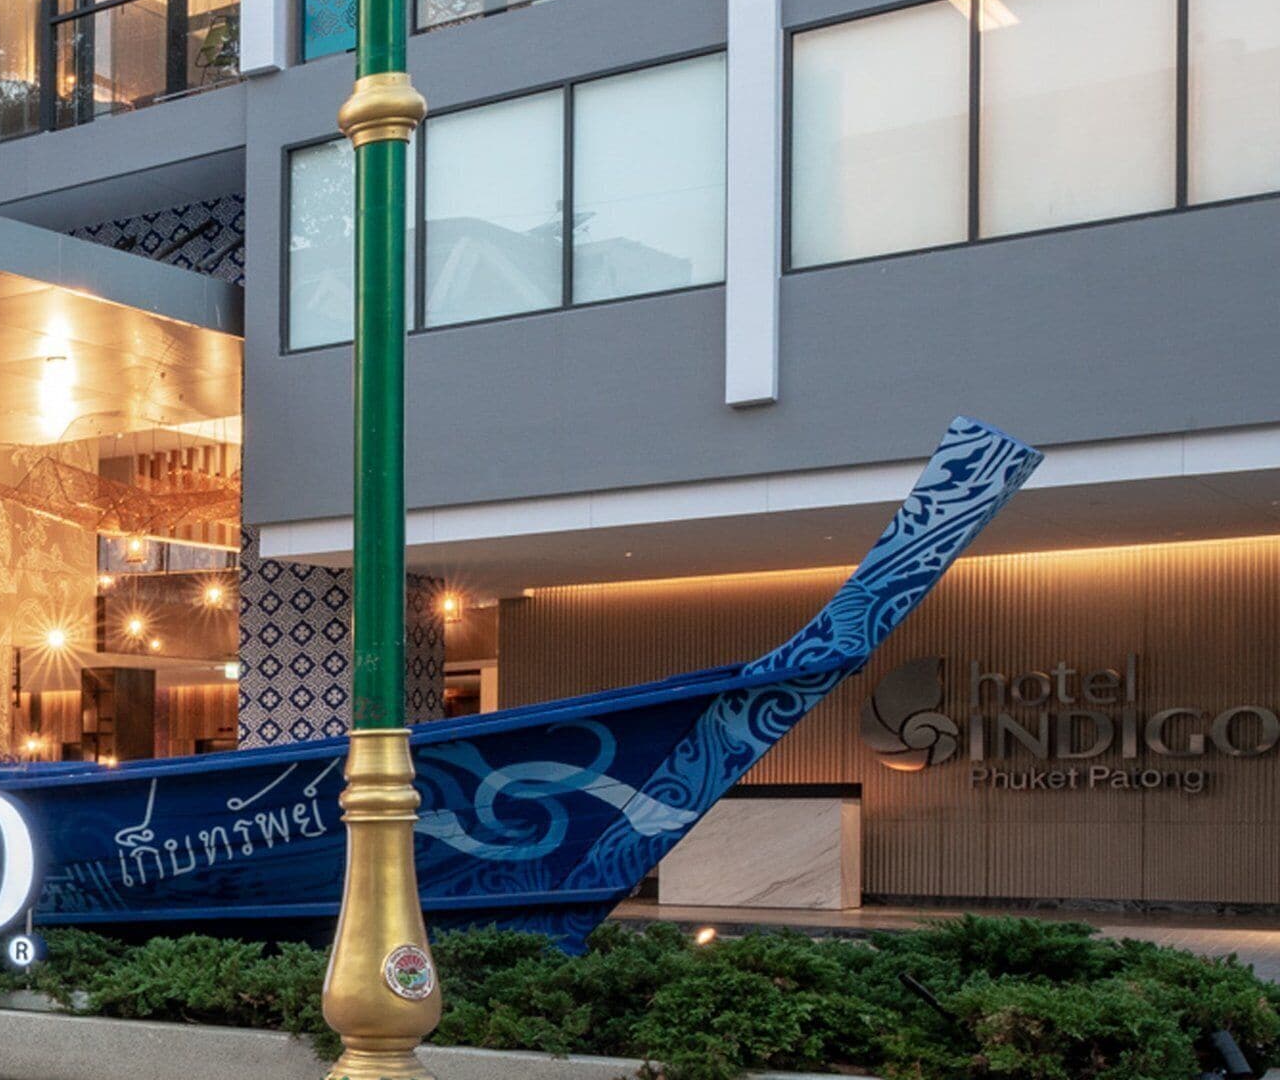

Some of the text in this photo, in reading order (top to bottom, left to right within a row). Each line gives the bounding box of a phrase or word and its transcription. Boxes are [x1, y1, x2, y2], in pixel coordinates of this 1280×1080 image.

[970, 651, 1136, 709] hotel
[969, 705, 1280, 762] INDIGO
[970, 765, 1205, 794] Phuket Patong
